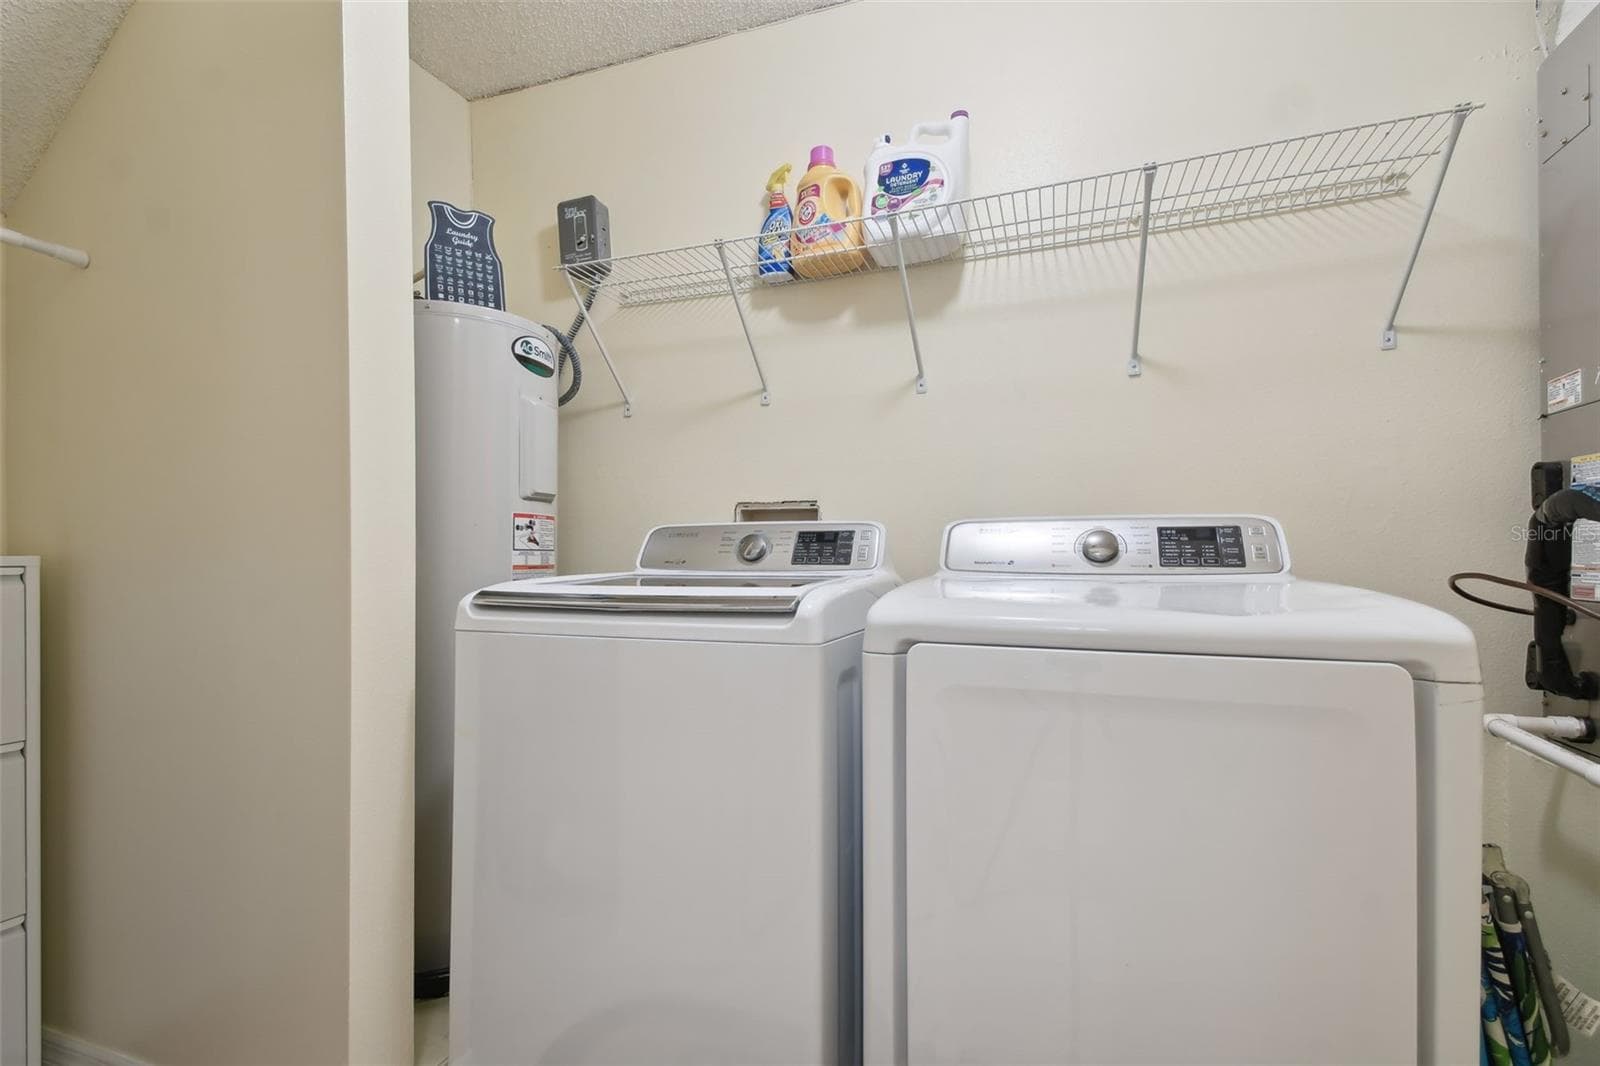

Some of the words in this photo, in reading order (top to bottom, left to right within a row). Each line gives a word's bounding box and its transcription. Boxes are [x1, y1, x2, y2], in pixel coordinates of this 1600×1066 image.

[885, 170, 924, 185] LAUNDRY
[446, 228, 478, 242] Laundry
[451, 236, 473, 248] Guide
